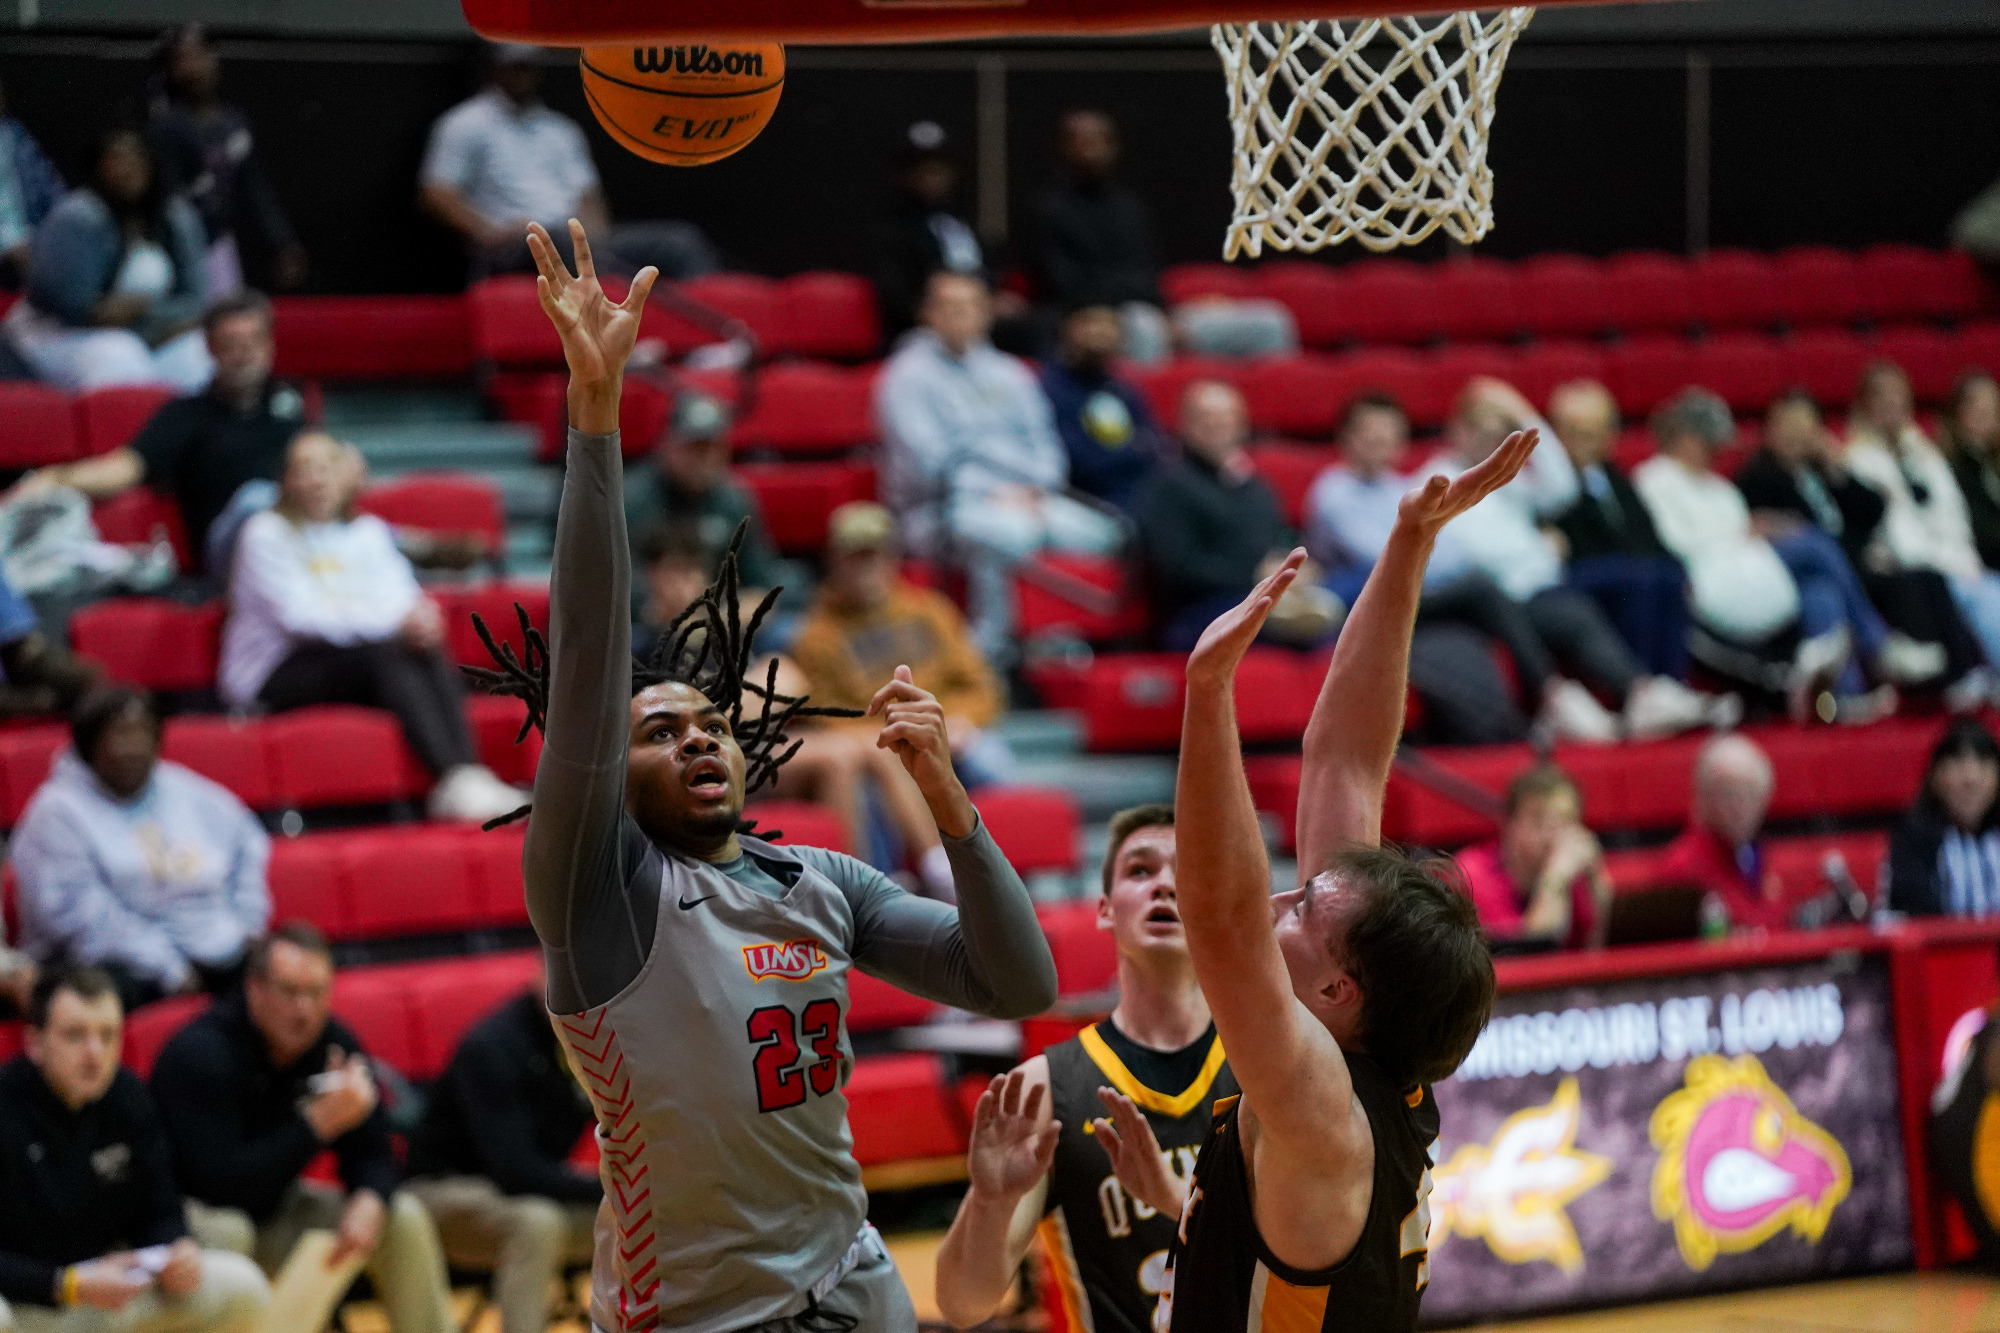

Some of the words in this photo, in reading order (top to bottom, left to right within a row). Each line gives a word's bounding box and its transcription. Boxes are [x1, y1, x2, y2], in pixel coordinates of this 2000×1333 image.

[634, 45, 763, 77] Wilson
[744, 942, 826, 980] UMSL
[746, 998, 843, 1113] 23
[1460, 1002, 1659, 1082] MISSOURI
[1721, 983, 1844, 1055] LOUIS
